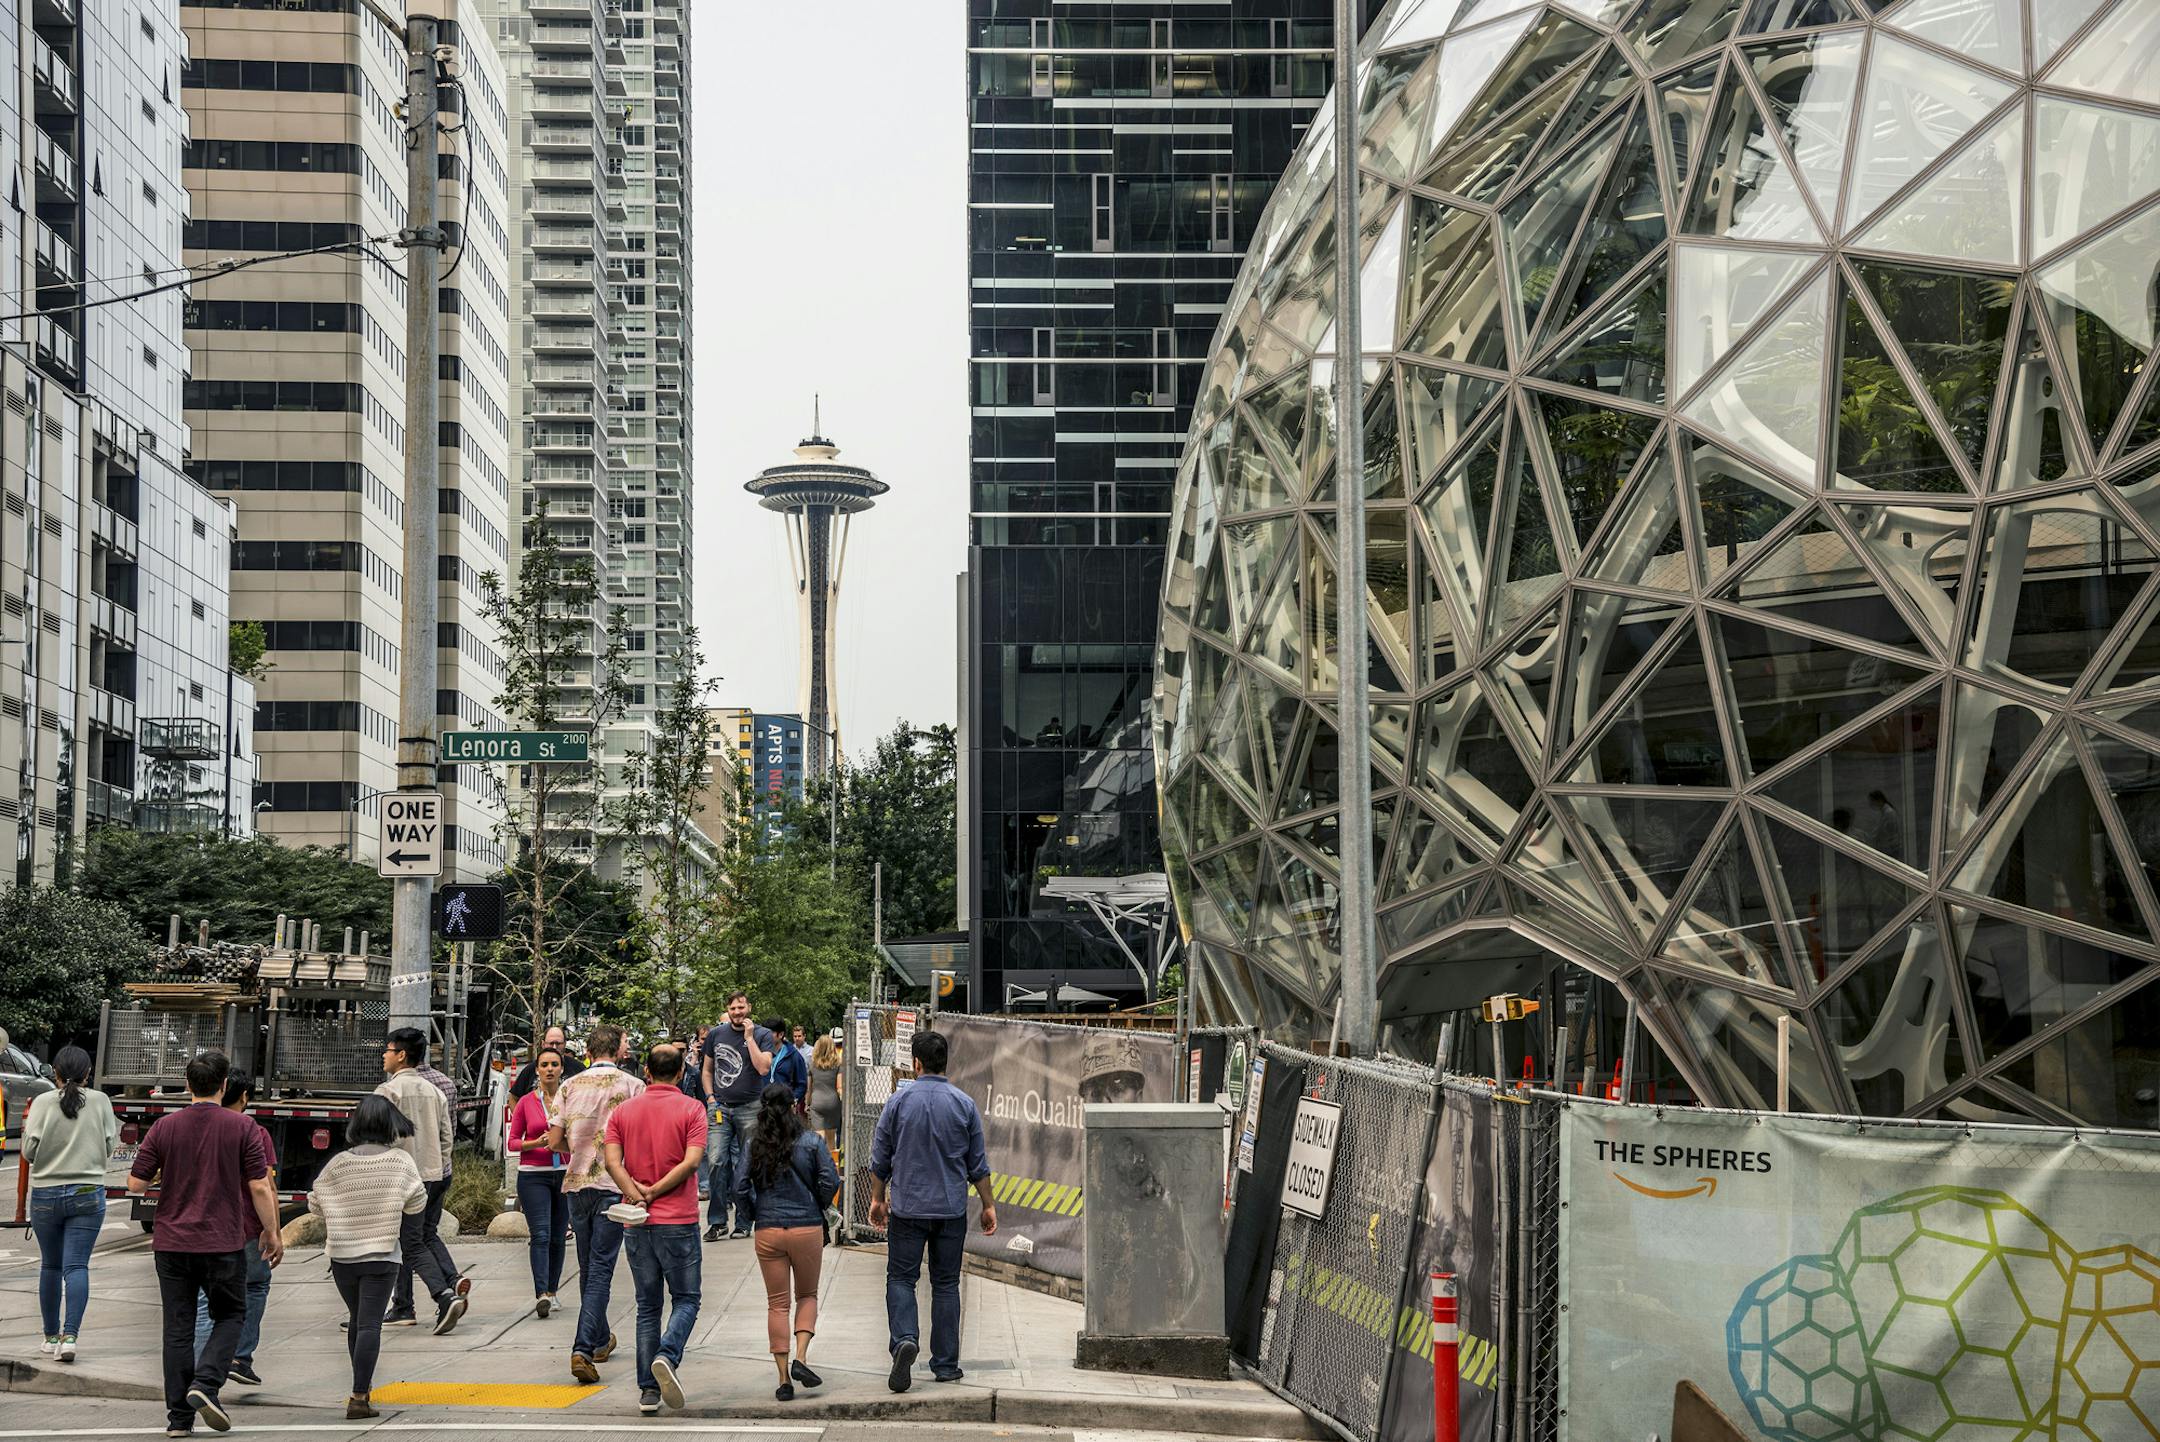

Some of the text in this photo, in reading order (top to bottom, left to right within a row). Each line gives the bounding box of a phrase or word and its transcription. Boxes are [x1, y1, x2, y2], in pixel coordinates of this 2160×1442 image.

[448, 734, 585, 757] Lenora St 2100
[768, 724, 783, 764] APTS
[768, 769, 784, 807] NO
[387, 801, 436, 820] ONE
[386, 824, 437, 842] WAY
[984, 1084, 1085, 1129] I am Qualit
[1295, 1113, 1336, 1149] SIDEWALK
[112, 1149, 137, 1159] C5572
[1594, 1140, 1772, 1173] THE SPHERES
[1288, 1161, 1325, 1200] CLOSED
